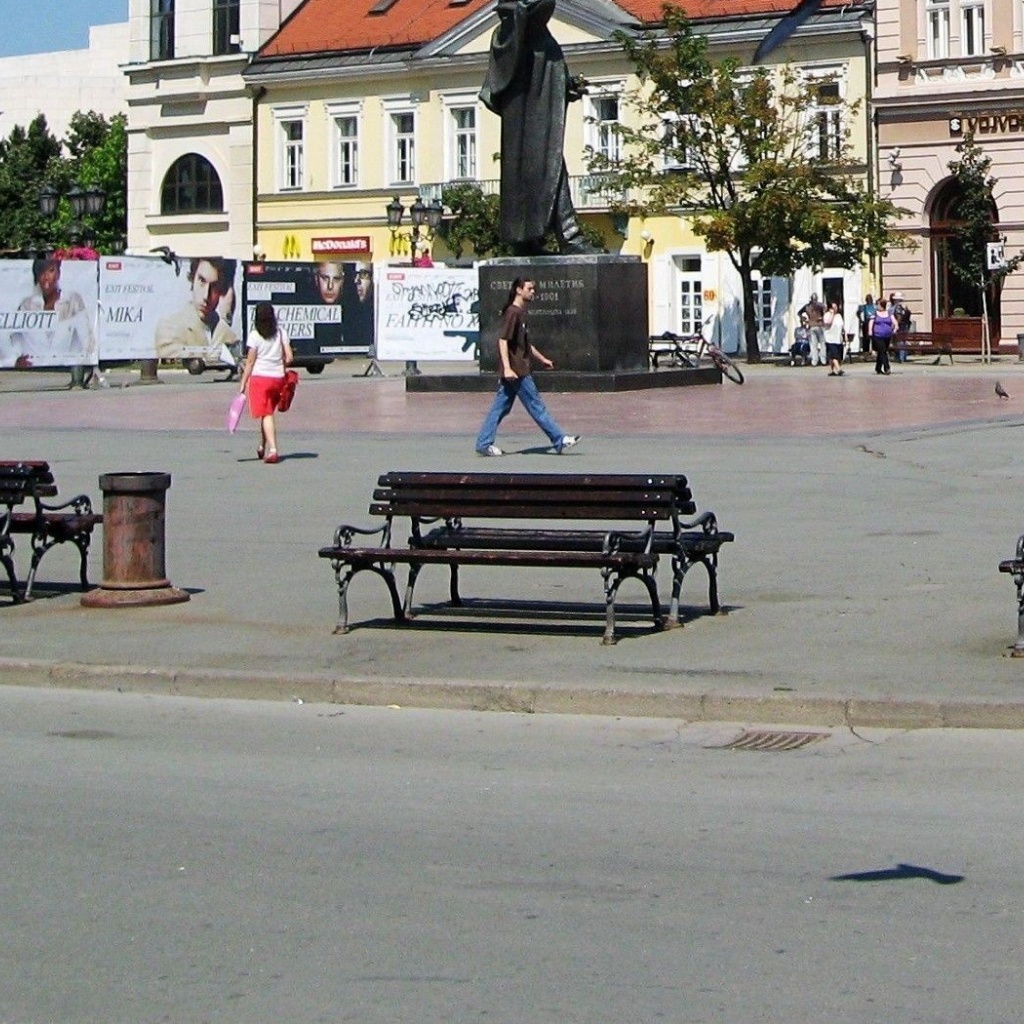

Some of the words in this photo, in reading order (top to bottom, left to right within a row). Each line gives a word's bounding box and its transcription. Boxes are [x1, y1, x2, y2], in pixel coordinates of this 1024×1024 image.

[313, 239, 367, 250] McDonald's
[107, 307, 143, 322] MIKA
[277, 307, 339, 322] CHEMICAL
